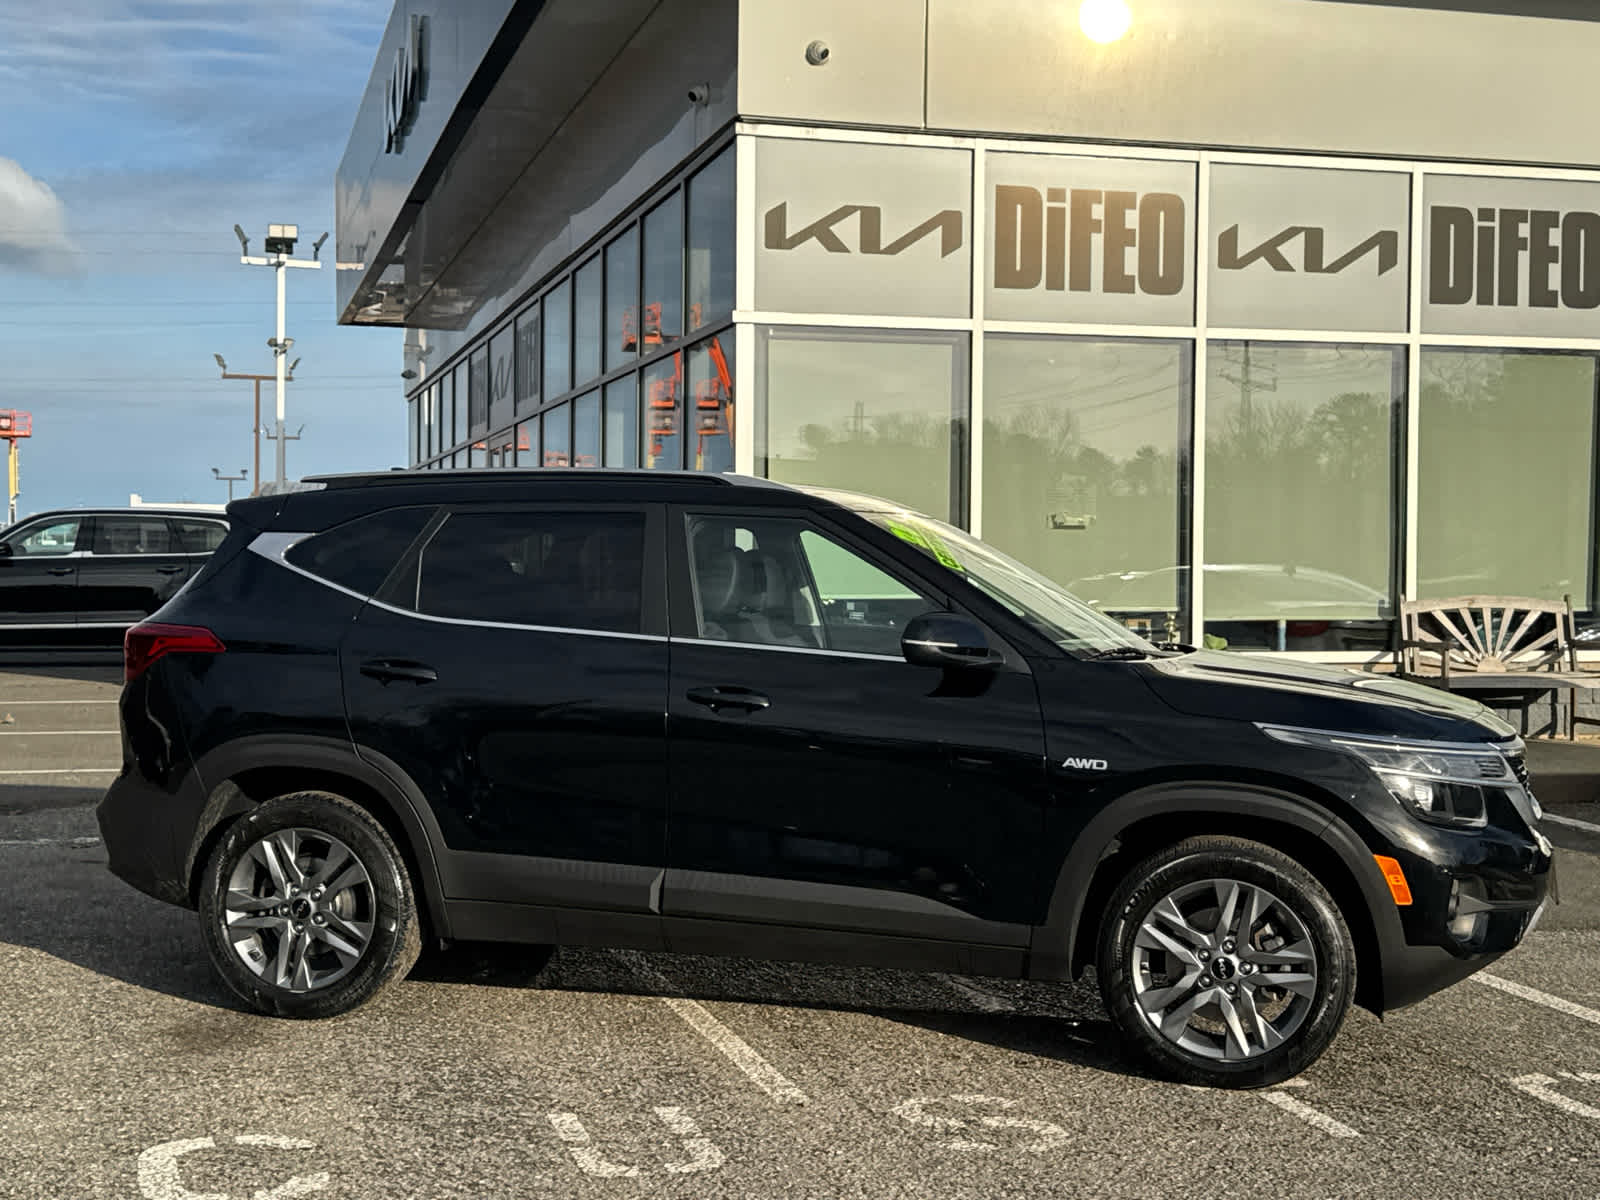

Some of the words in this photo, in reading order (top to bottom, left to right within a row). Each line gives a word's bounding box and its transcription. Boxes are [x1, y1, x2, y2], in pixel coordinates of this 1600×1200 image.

[764, 201, 963, 259] KIA
[1218, 223, 1398, 277] KIA
[1061, 757, 1108, 771] AWD
